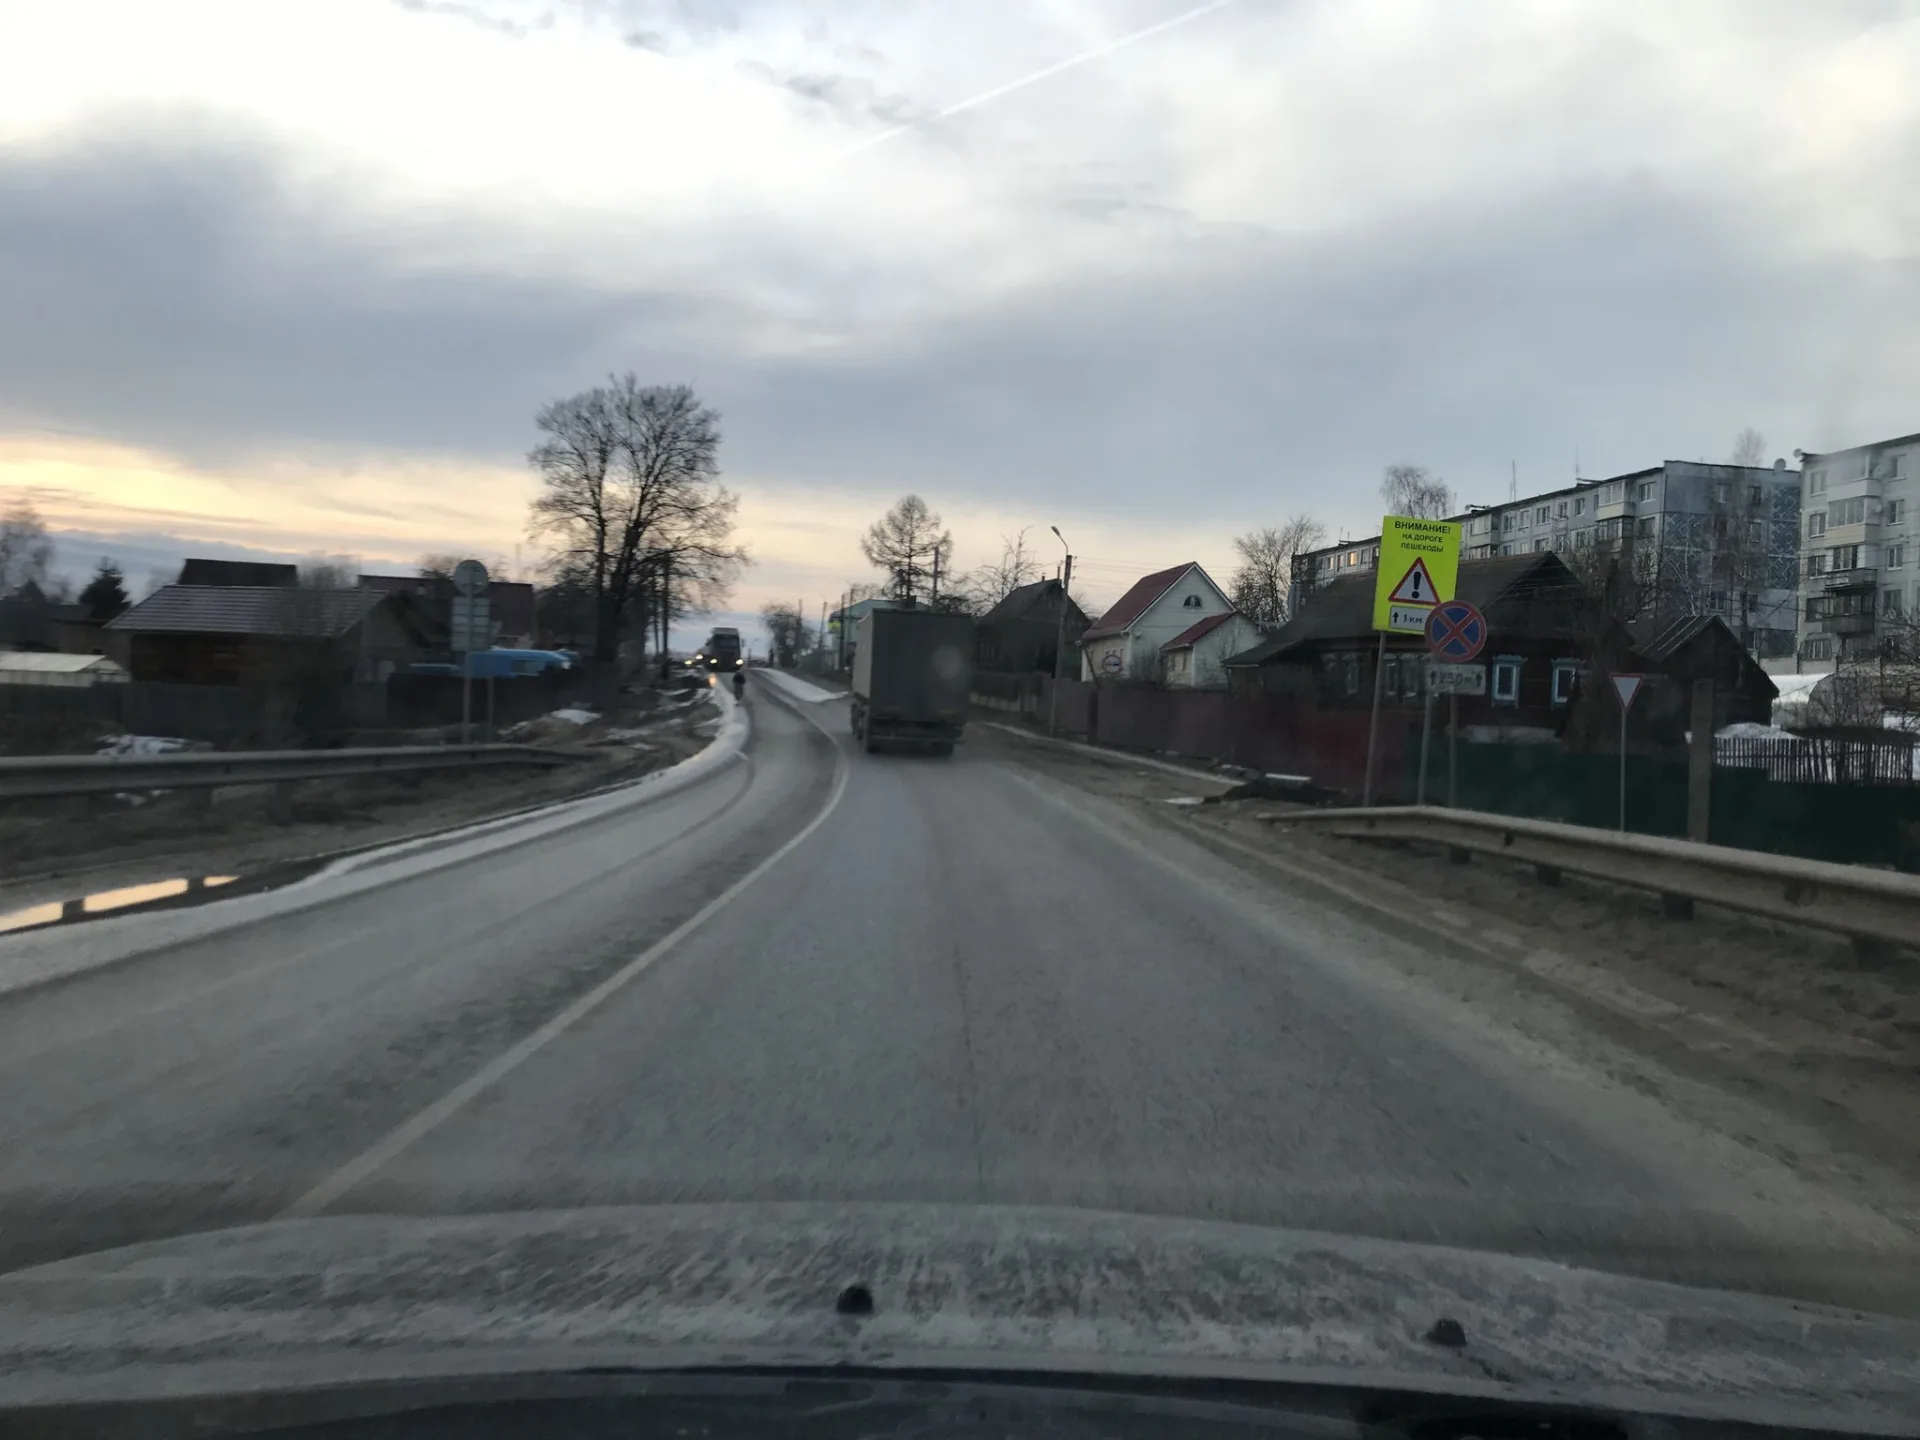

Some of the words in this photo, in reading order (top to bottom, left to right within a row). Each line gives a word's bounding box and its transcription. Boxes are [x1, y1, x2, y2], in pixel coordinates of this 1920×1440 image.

[1394, 520, 1451, 534] ВНИМАНИЕ!
[1413, 534, 1444, 543] ДОРОГЕ
[1400, 542, 1444, 552] ПЕШЕХОДЫ
